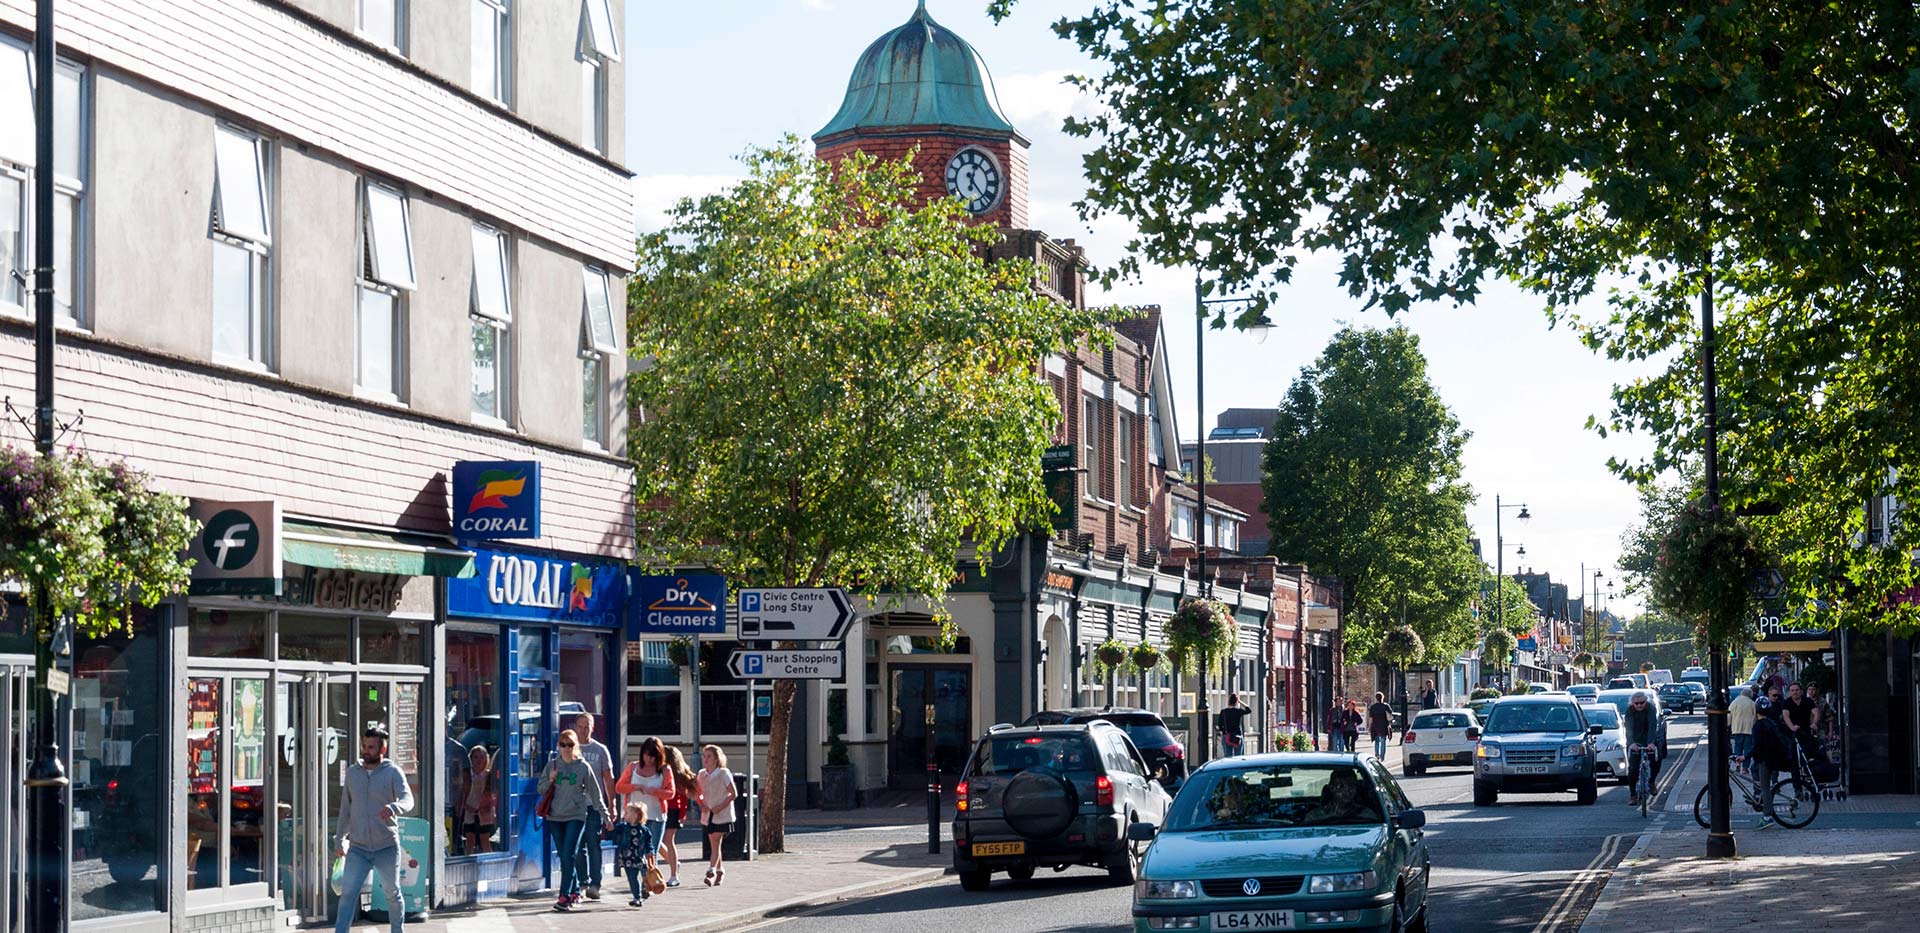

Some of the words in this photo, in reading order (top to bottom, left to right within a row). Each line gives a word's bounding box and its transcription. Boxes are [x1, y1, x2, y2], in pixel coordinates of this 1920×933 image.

[460, 517, 529, 532] CORAL
[488, 555, 565, 609] CORAL
[665, 588, 699, 605] Dry
[763, 592, 789, 601] Civic
[791, 592, 824, 601] Centre
[763, 603, 789, 613] Long
[791, 603, 813, 613] Stay
[647, 612, 716, 626] Cleaners
[766, 654, 788, 664] Hart
[792, 654, 838, 666] Shopping
[785, 665, 819, 674] Centre
[976, 844, 1000, 855] FY55
[1002, 843, 1020, 853] FTP
[1217, 913, 1249, 928] L64
[1254, 911, 1287, 927] XNH
